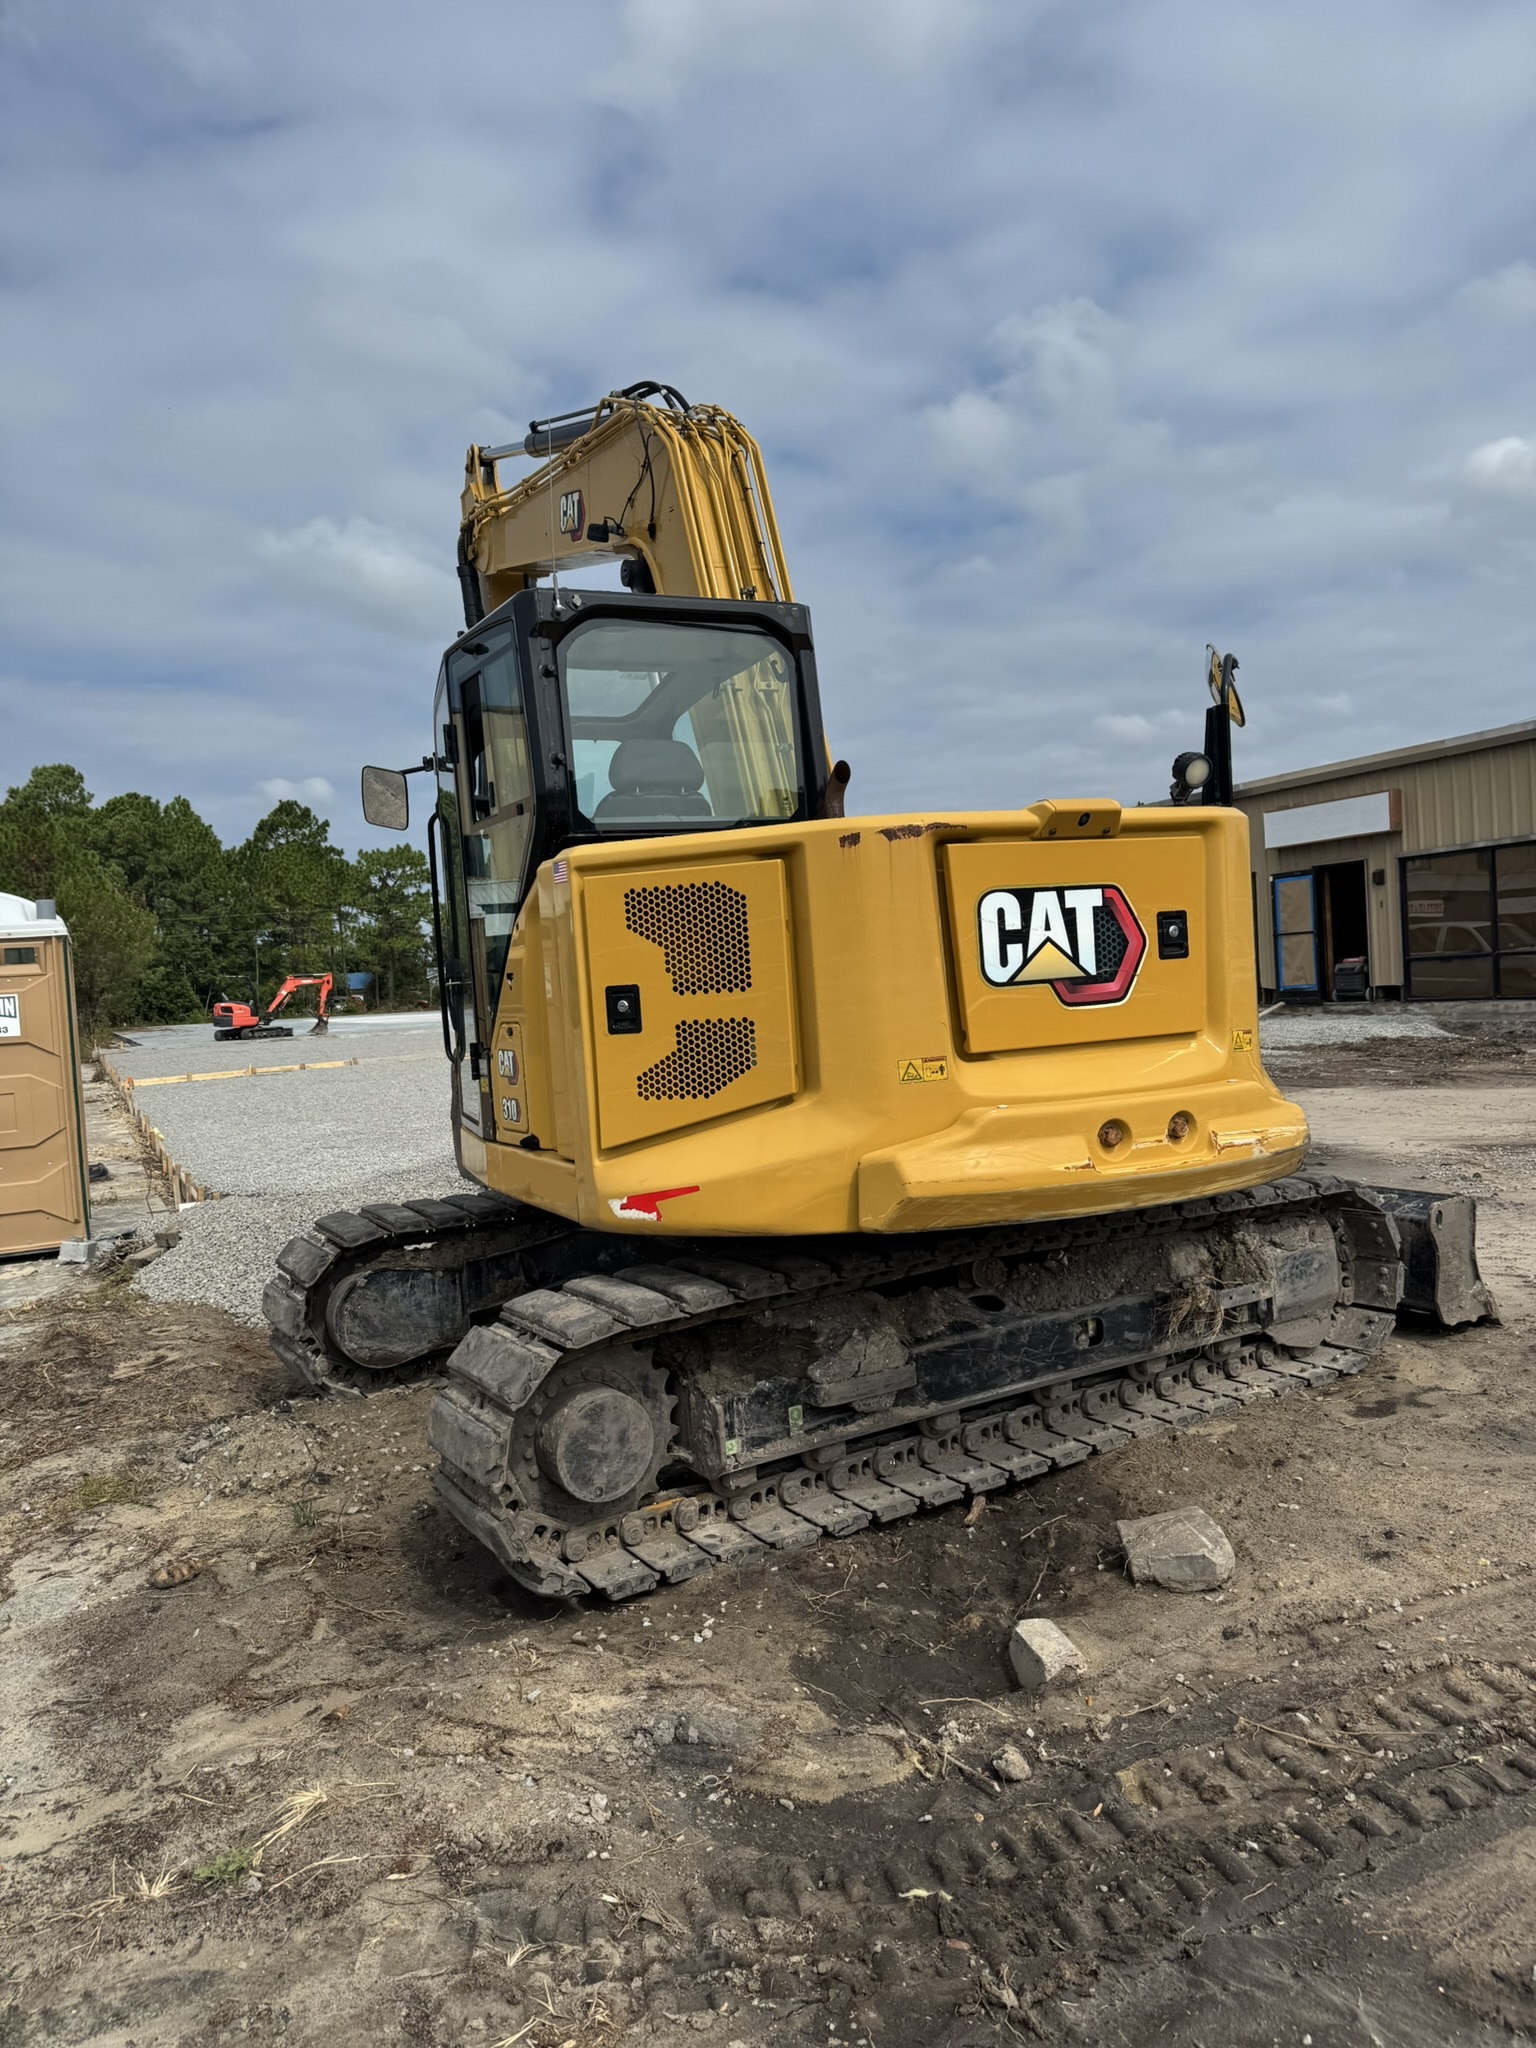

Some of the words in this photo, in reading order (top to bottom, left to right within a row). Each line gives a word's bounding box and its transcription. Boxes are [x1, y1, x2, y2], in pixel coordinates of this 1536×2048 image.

[560, 491, 580, 532] CAT
[980, 888, 1103, 983] CAT
[498, 1050, 514, 1076] CAT
[502, 1098, 518, 1121] 310
